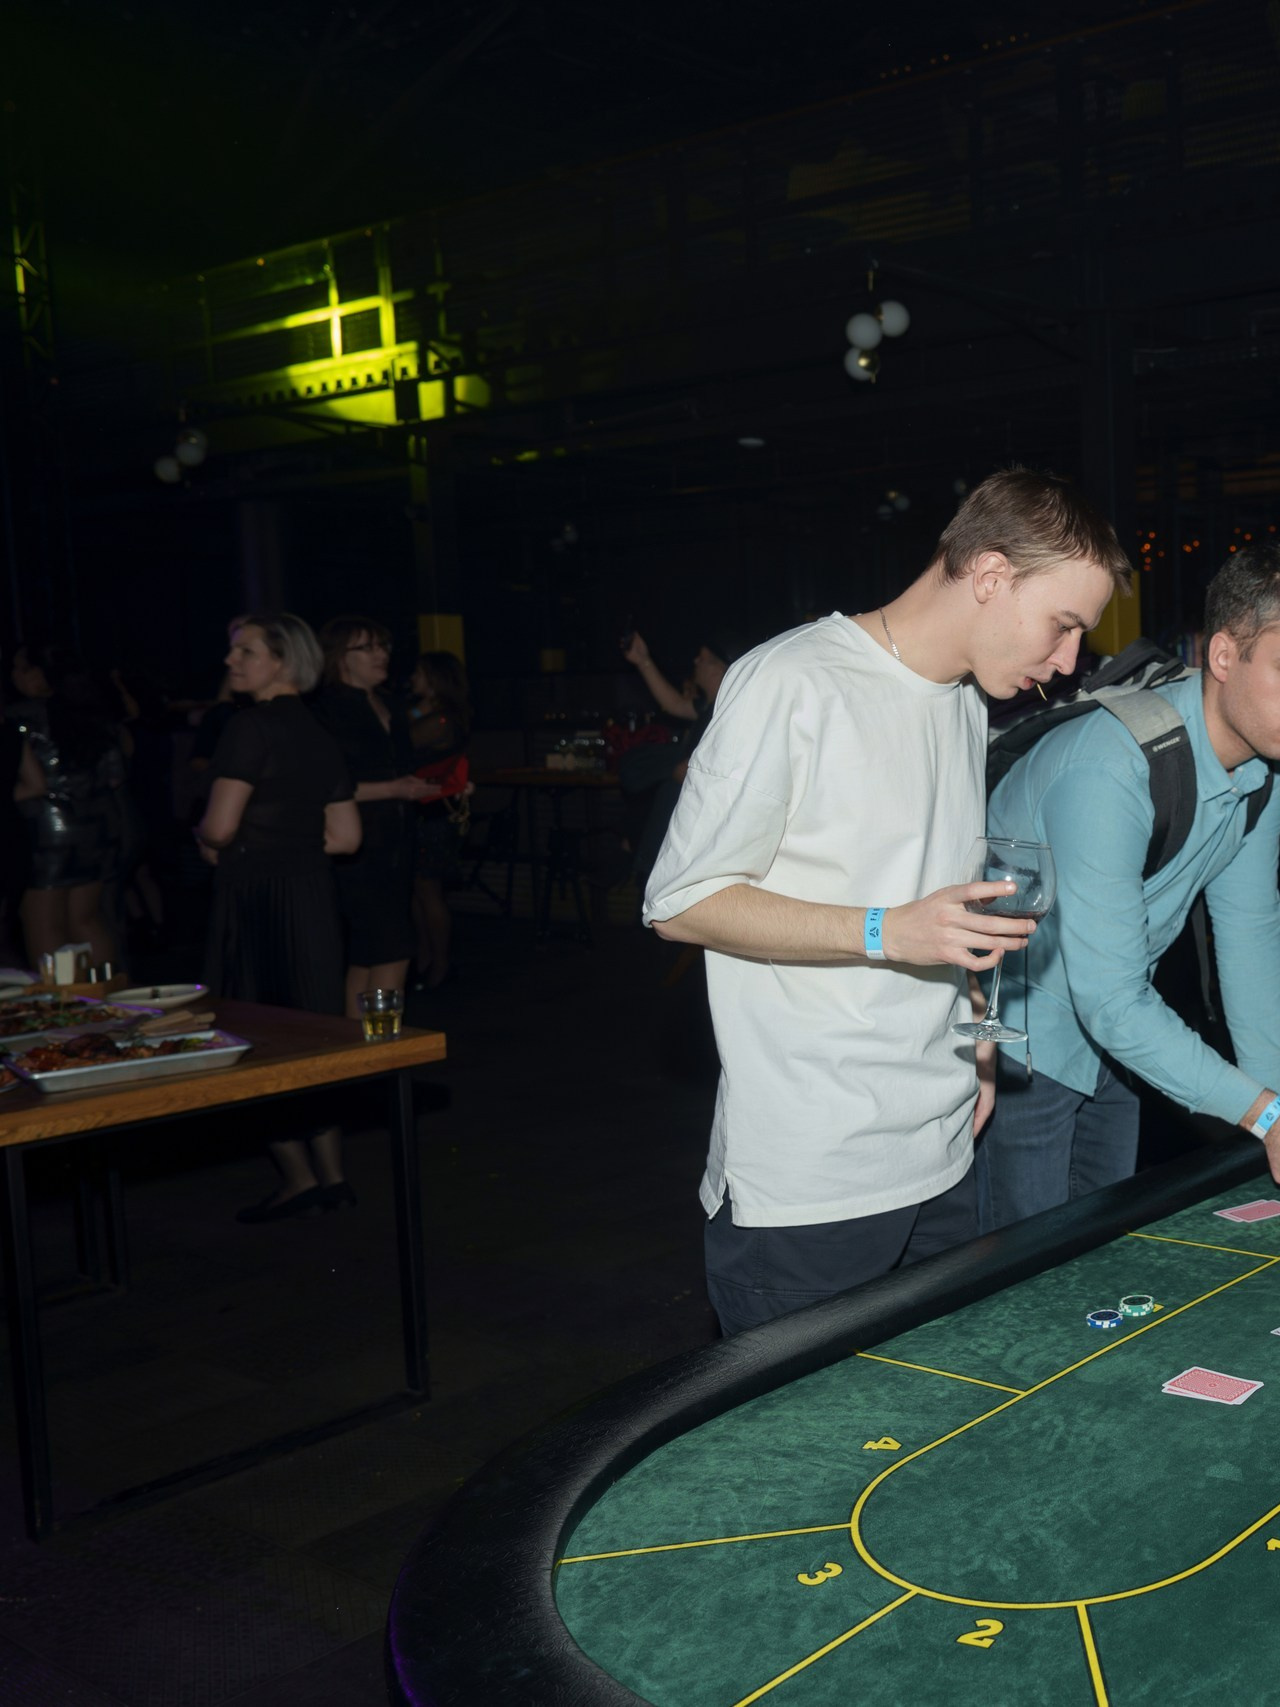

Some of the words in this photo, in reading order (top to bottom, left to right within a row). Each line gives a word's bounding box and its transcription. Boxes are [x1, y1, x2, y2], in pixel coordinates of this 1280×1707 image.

[862, 1436, 902, 1451] 4
[797, 1562, 843, 1586] 3
[957, 1618, 1004, 1649] 2
